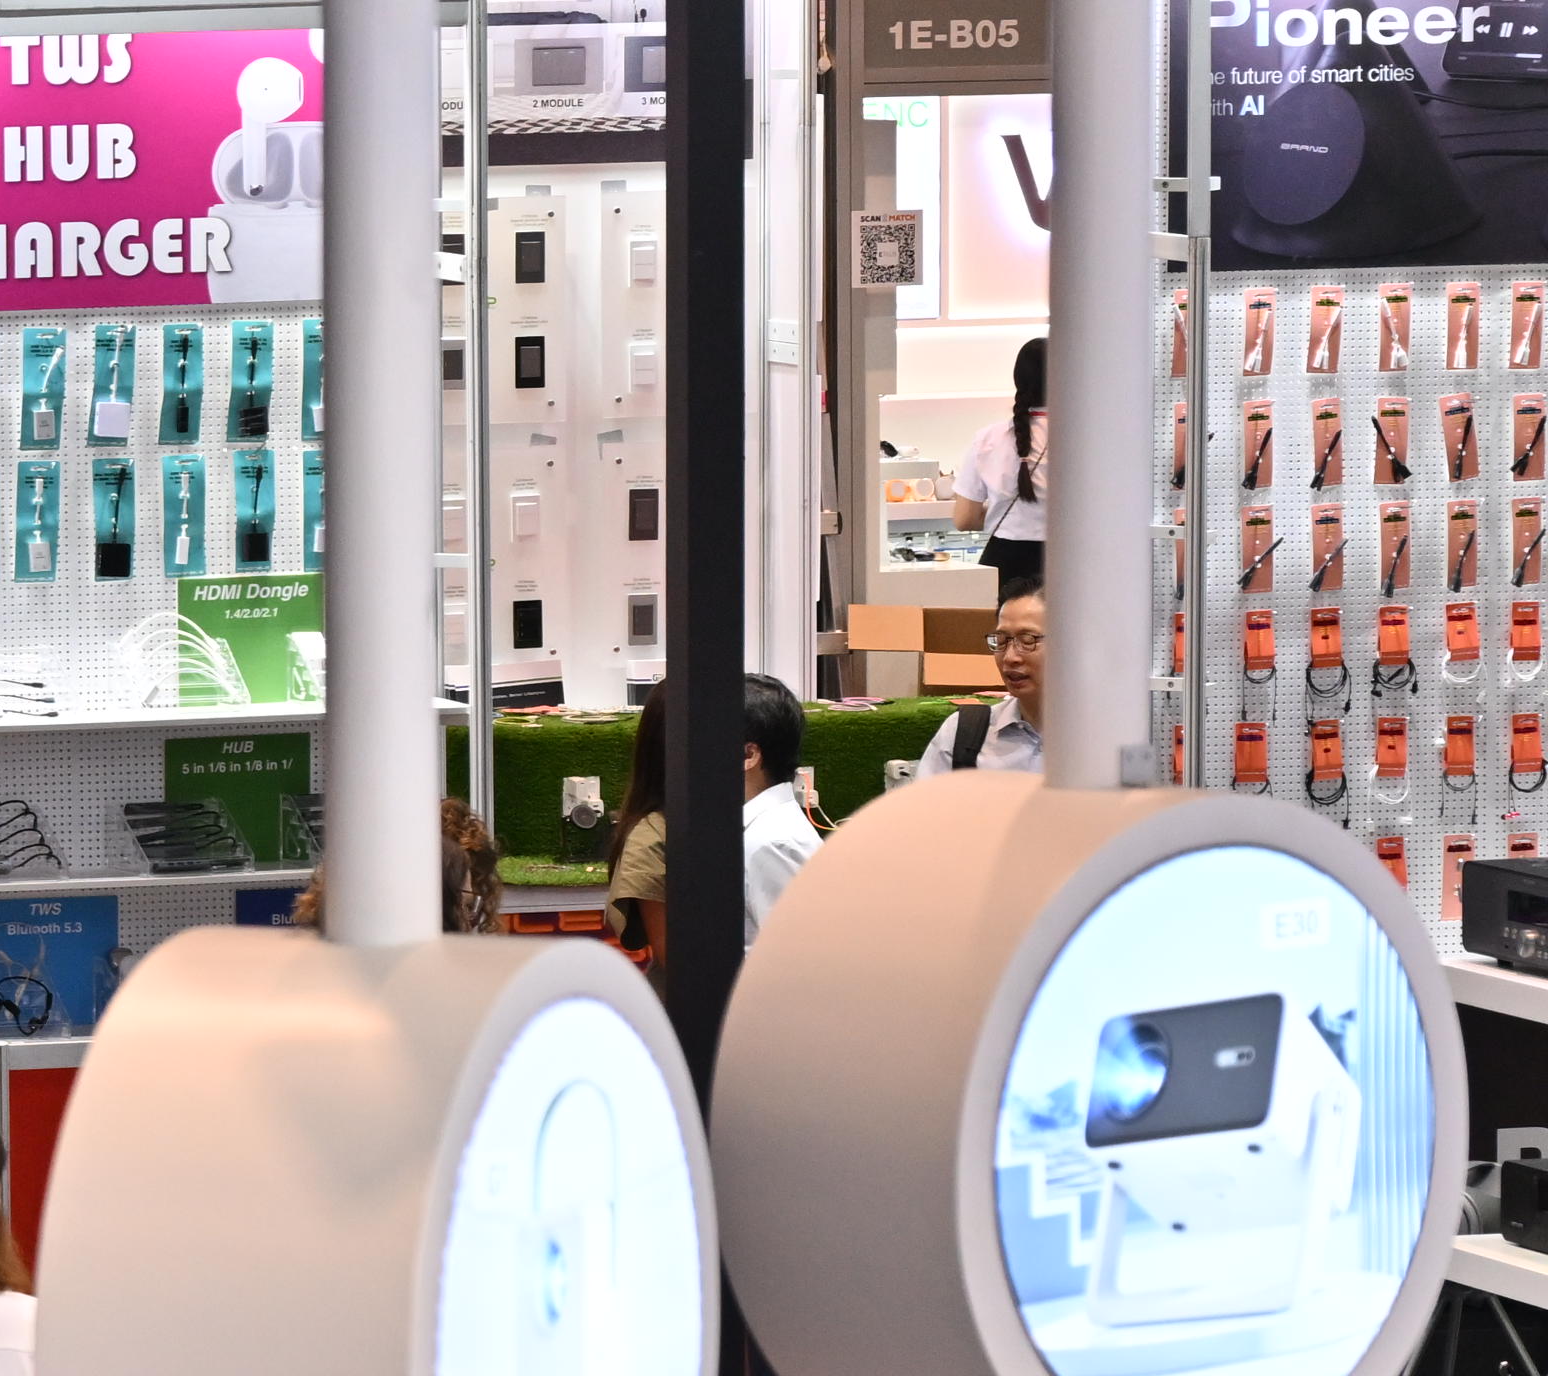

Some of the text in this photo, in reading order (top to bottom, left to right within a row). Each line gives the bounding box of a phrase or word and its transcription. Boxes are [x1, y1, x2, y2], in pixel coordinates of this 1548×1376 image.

[888, 19, 1020, 50] 1E-B05
[1231, 66, 1284, 85] future
[1288, 65, 1307, 84] of
[1311, 65, 1364, 84] smart
[1367, 63, 1415, 83] cities
[532, 98, 585, 109] 2 MODULE
[1239, 95, 1265, 117] AI
[2, 123, 137, 183] HUB
[194, 581, 310, 603] HDMI Dongle
[222, 740, 255, 754] HUB
[29, 903, 62, 916] TWS
[64, 921, 83, 934] 5.3
